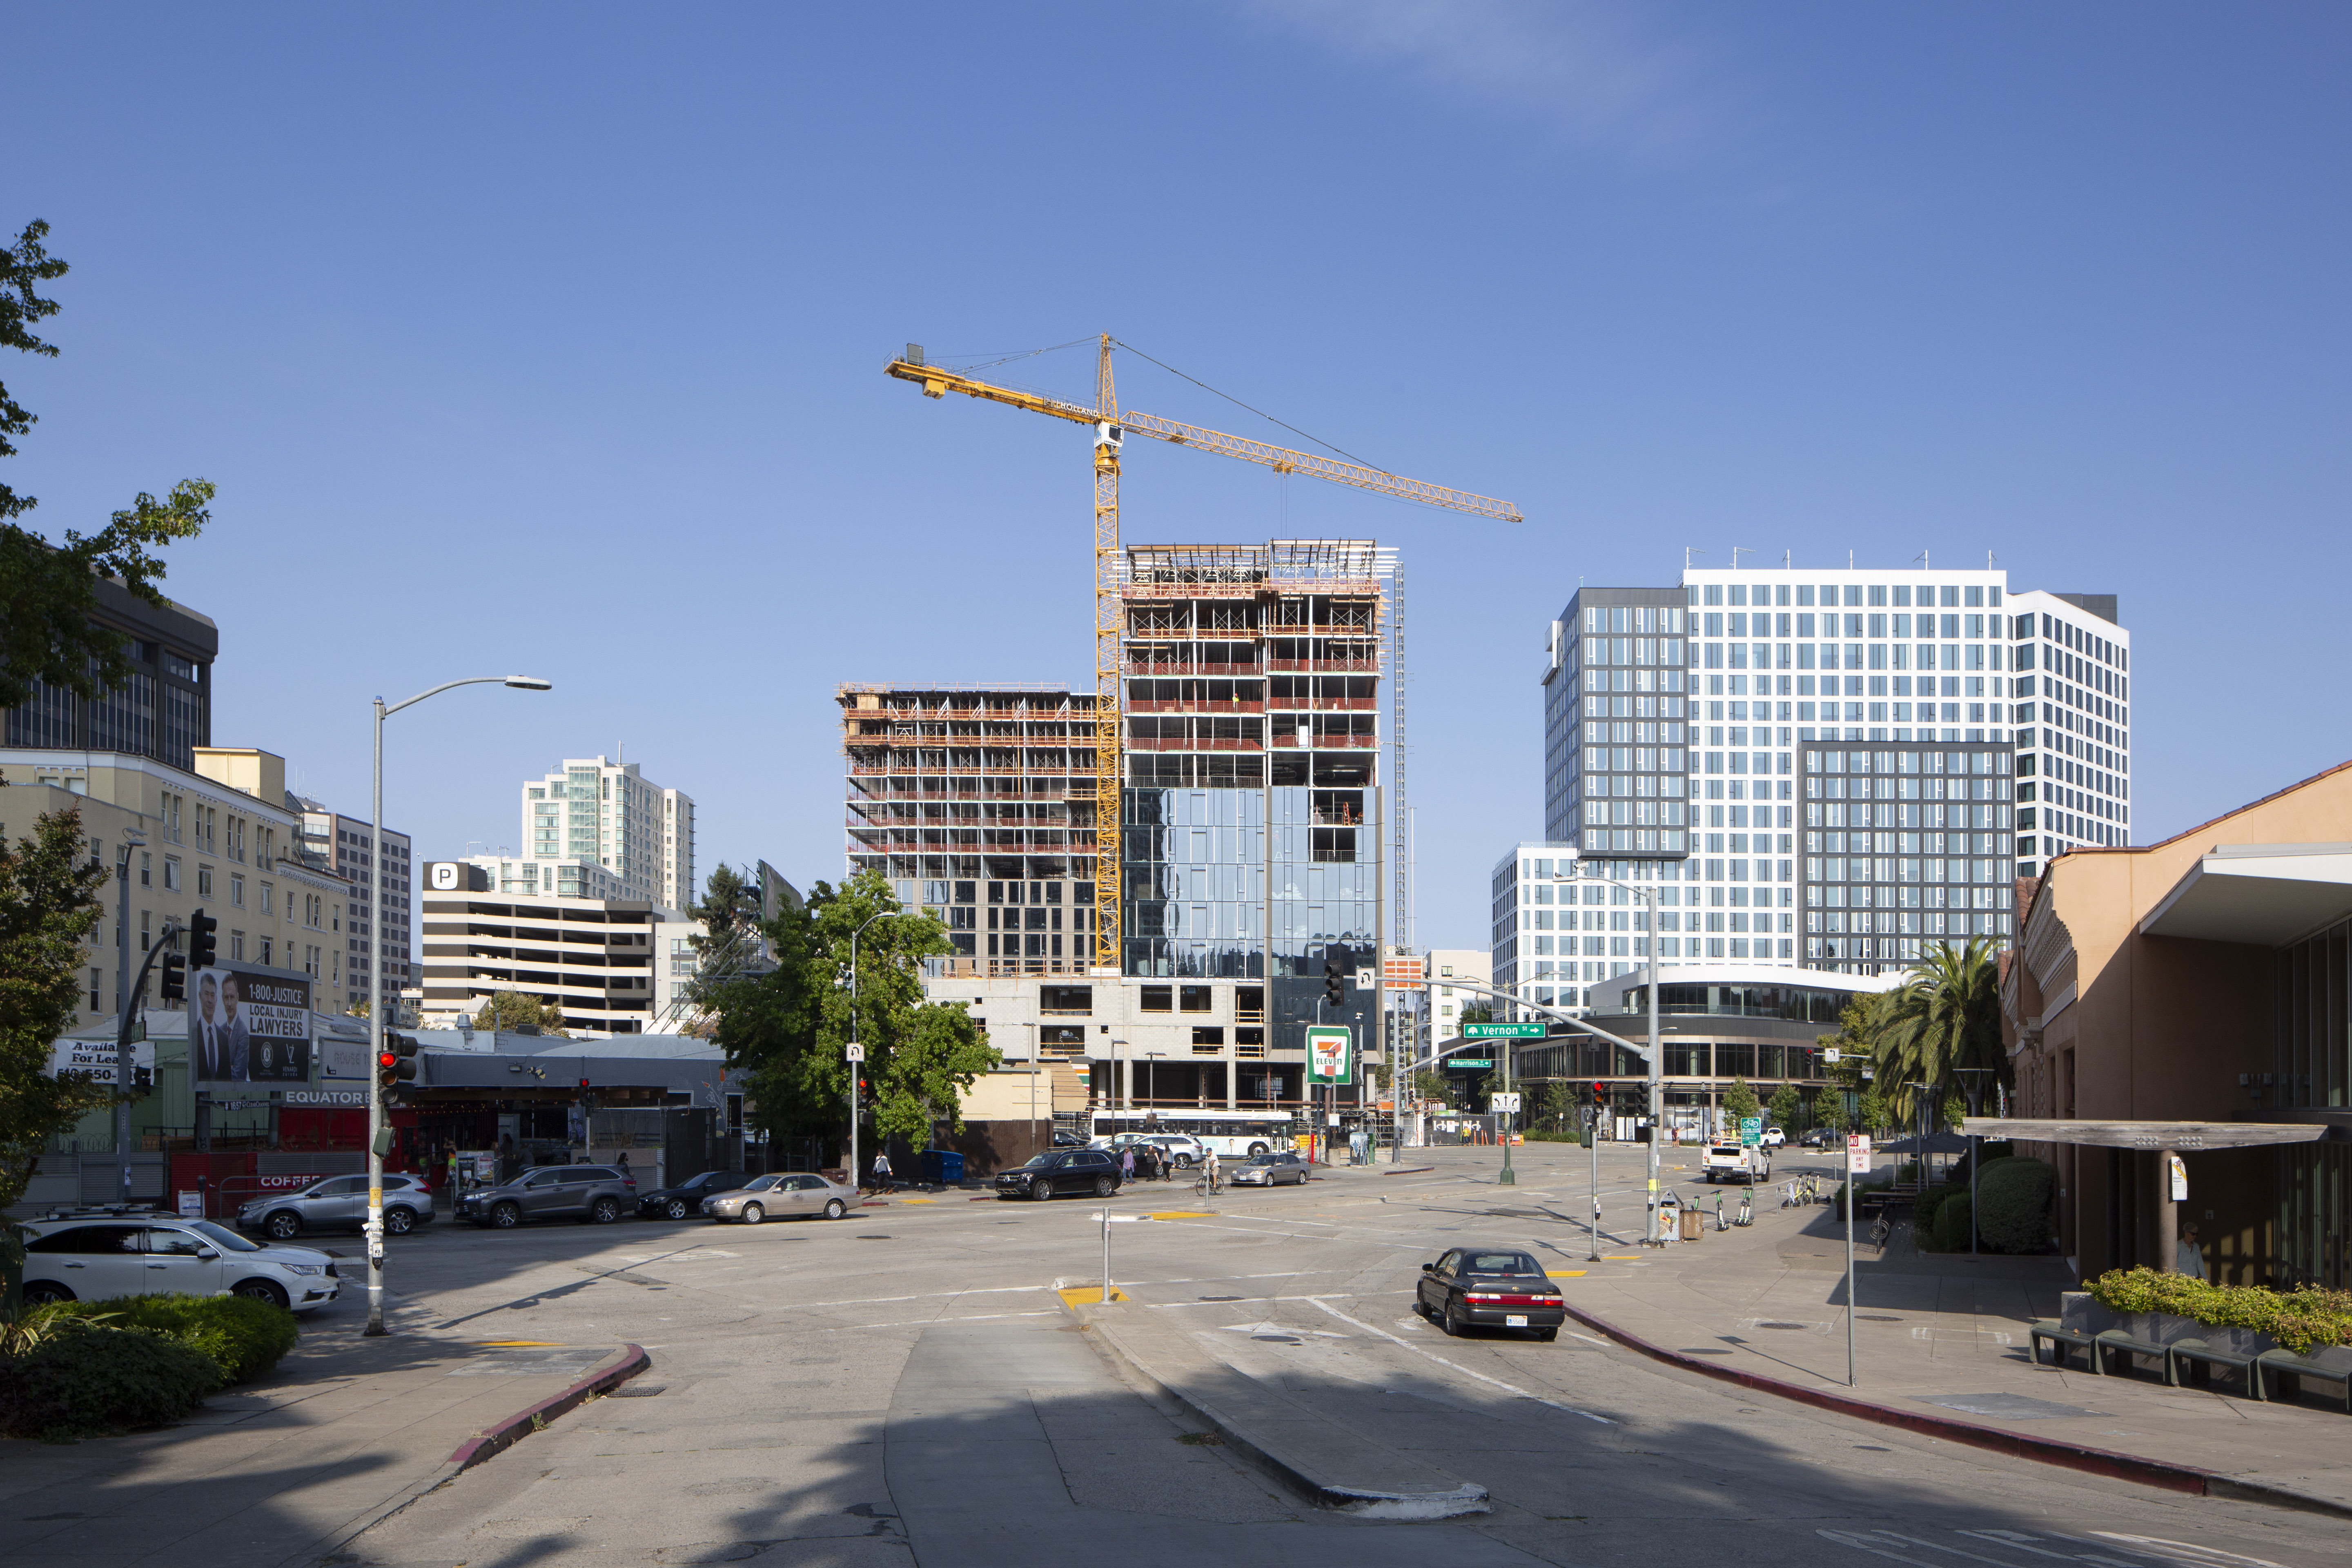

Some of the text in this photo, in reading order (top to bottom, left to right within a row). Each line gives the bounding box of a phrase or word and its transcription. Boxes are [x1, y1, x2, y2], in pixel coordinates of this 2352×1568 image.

[1060, 401, 1098, 417] HOLLAND
[440, 869, 451, 883] P
[250, 1004, 303, 1020] LOCAL INJURY
[250, 1017, 303, 1037] LAWYERS
[1482, 1026, 1518, 1035] Vernon
[72, 1042, 136, 1052] Availae
[72, 1053, 134, 1065] For Leae
[230, 1102, 242, 1110] 1657
[1850, 1137, 1858, 1145] NO
